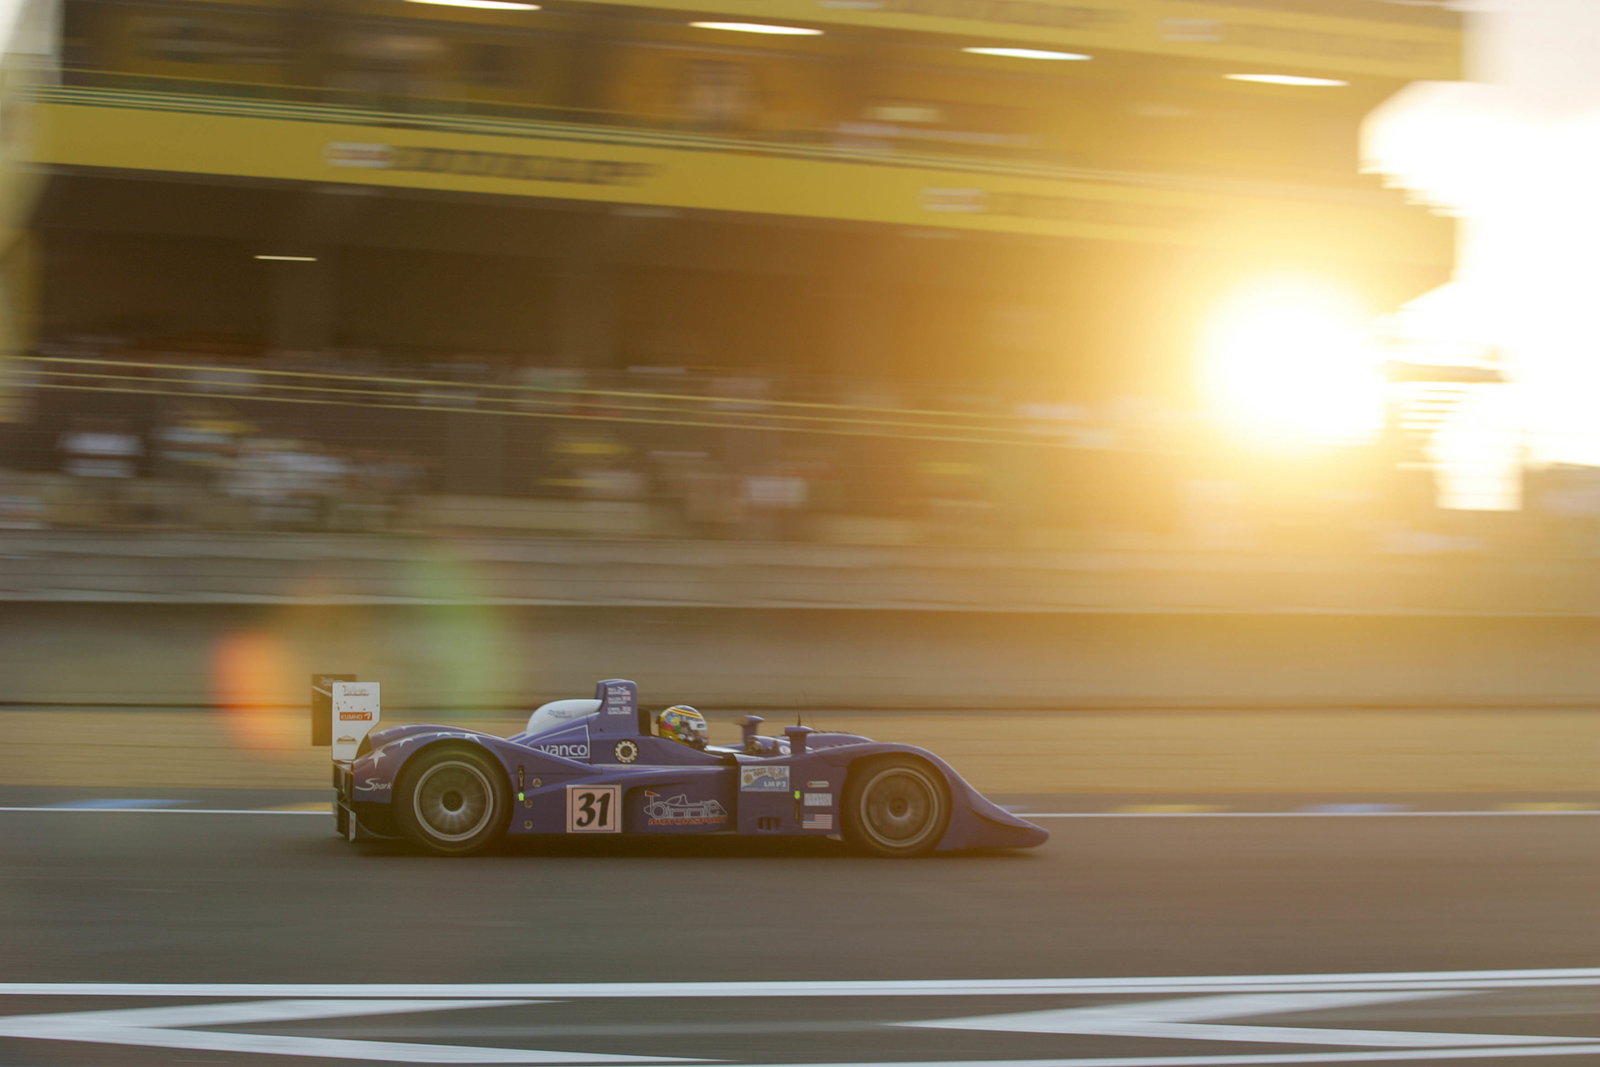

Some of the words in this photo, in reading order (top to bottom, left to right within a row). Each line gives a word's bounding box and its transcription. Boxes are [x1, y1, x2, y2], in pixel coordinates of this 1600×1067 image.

[540, 744, 588, 757] vanco
[355, 777, 392, 792] Spark
[576, 792, 611, 827] 31
